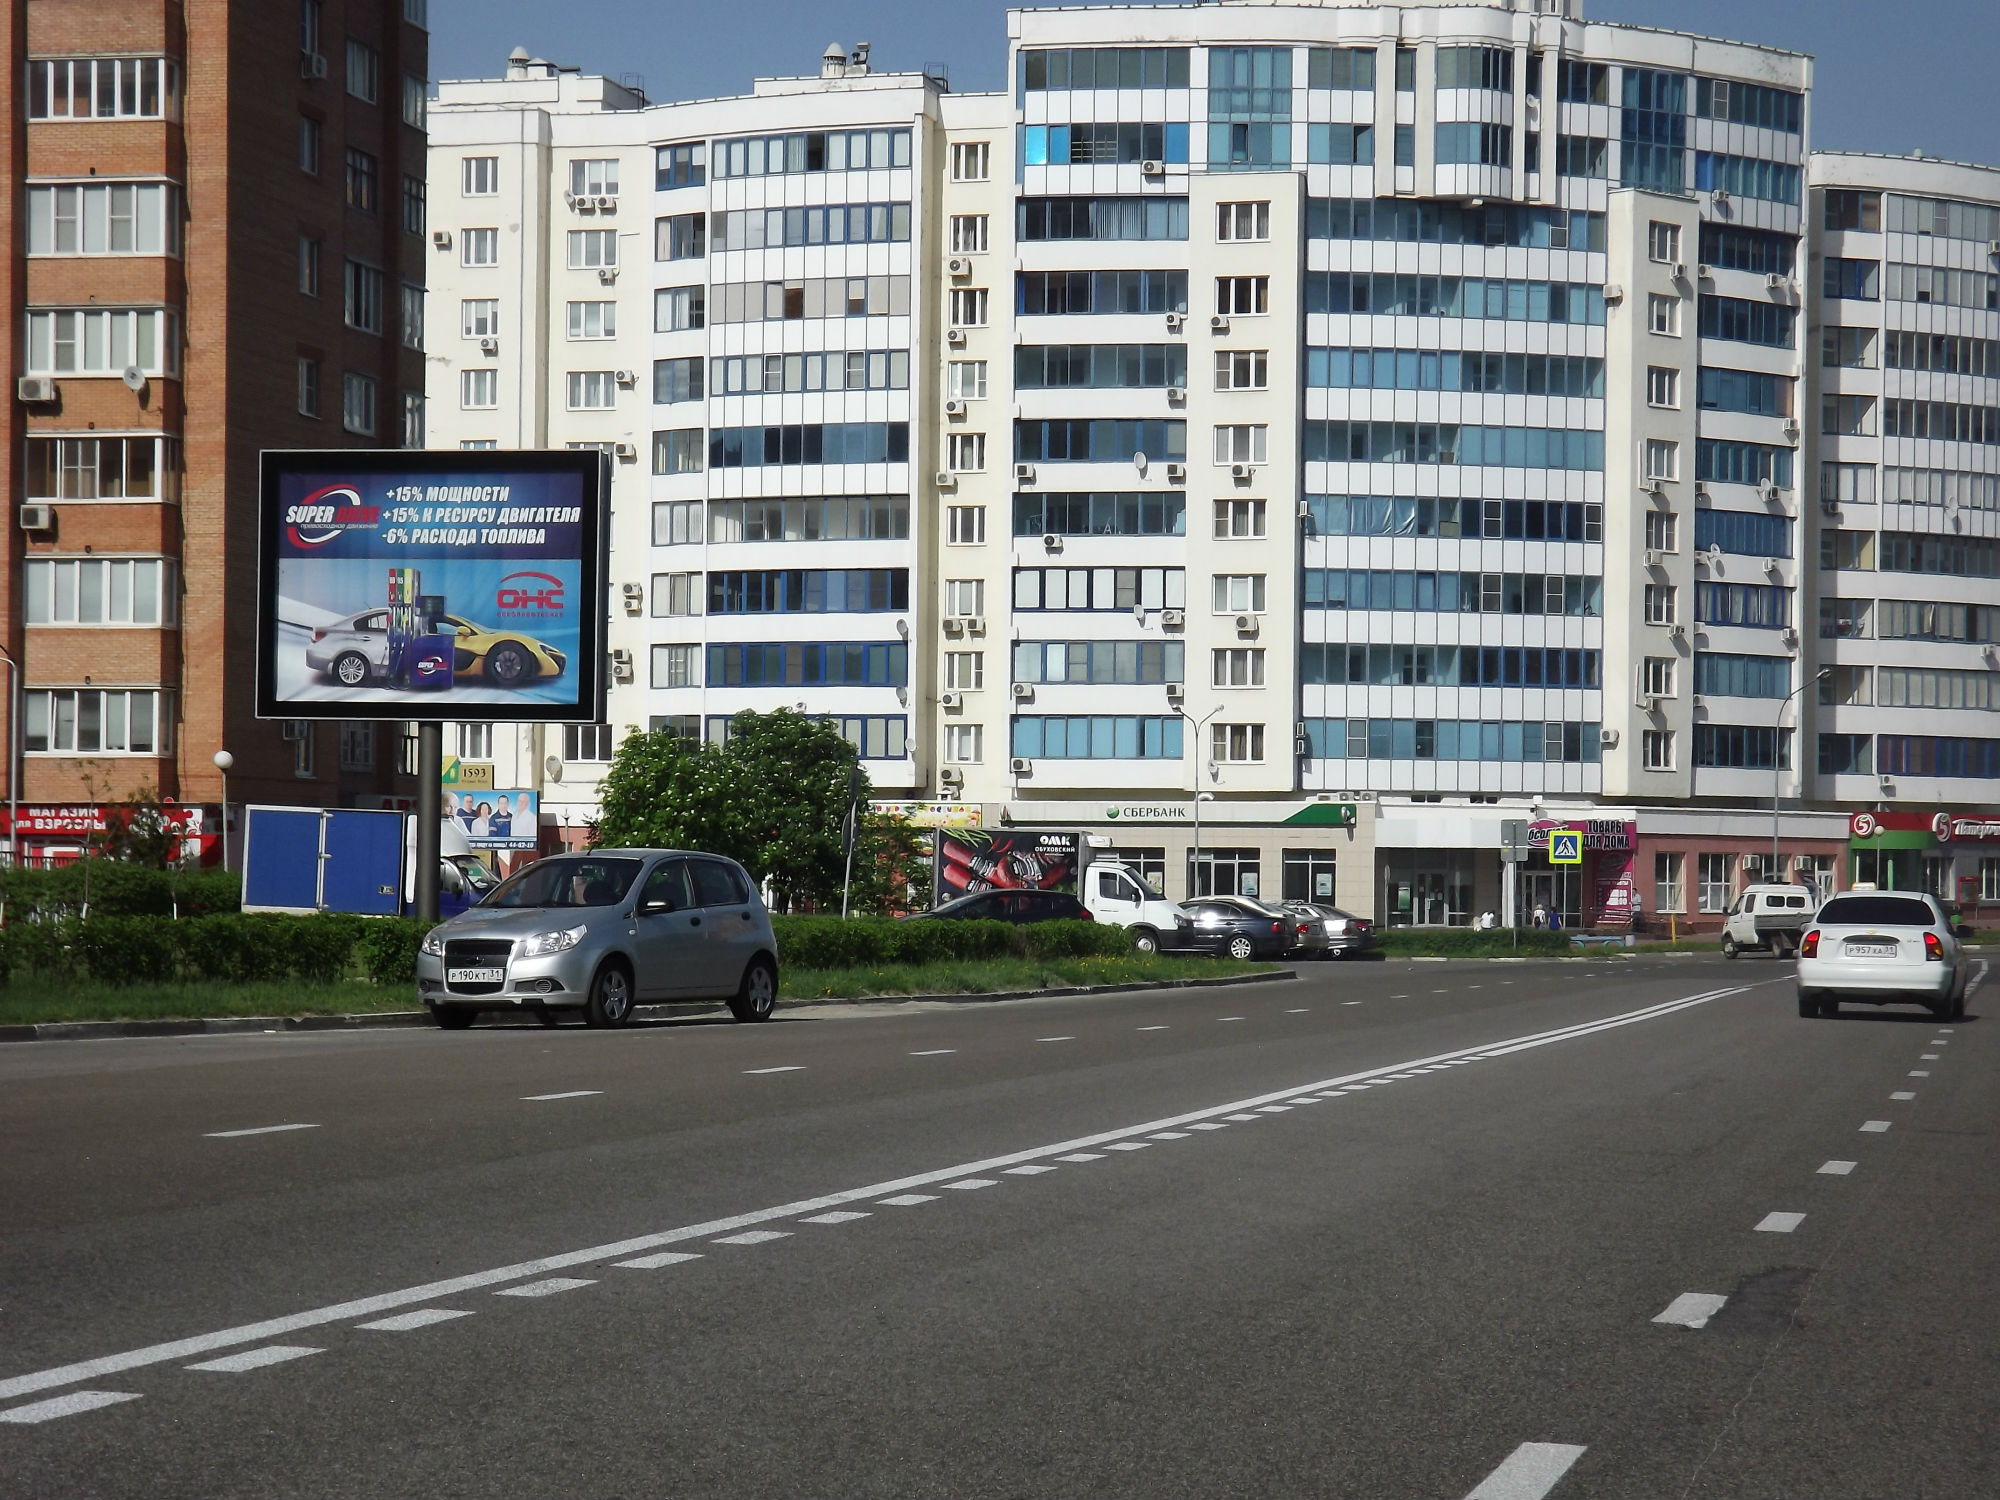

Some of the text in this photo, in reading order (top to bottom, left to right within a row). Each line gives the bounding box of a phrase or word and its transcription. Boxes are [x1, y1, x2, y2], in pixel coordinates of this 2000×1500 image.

[386, 486, 510, 503] +15% МОЩНОСТИ
[285, 505, 382, 524] SUPER DRIVE
[382, 506, 581, 525] +15% К РЕСУРСУ ДВИГАТЕЛЯ
[381, 528, 546, 546] -6% РАСХОДА ТОПЛИВА
[463, 768, 486, 778] 1593
[1123, 807, 1186, 817] СБЕРБАНК
[1587, 820, 1625, 834] ТОВАРЫ
[1603, 834, 1630, 850] ДОМА
